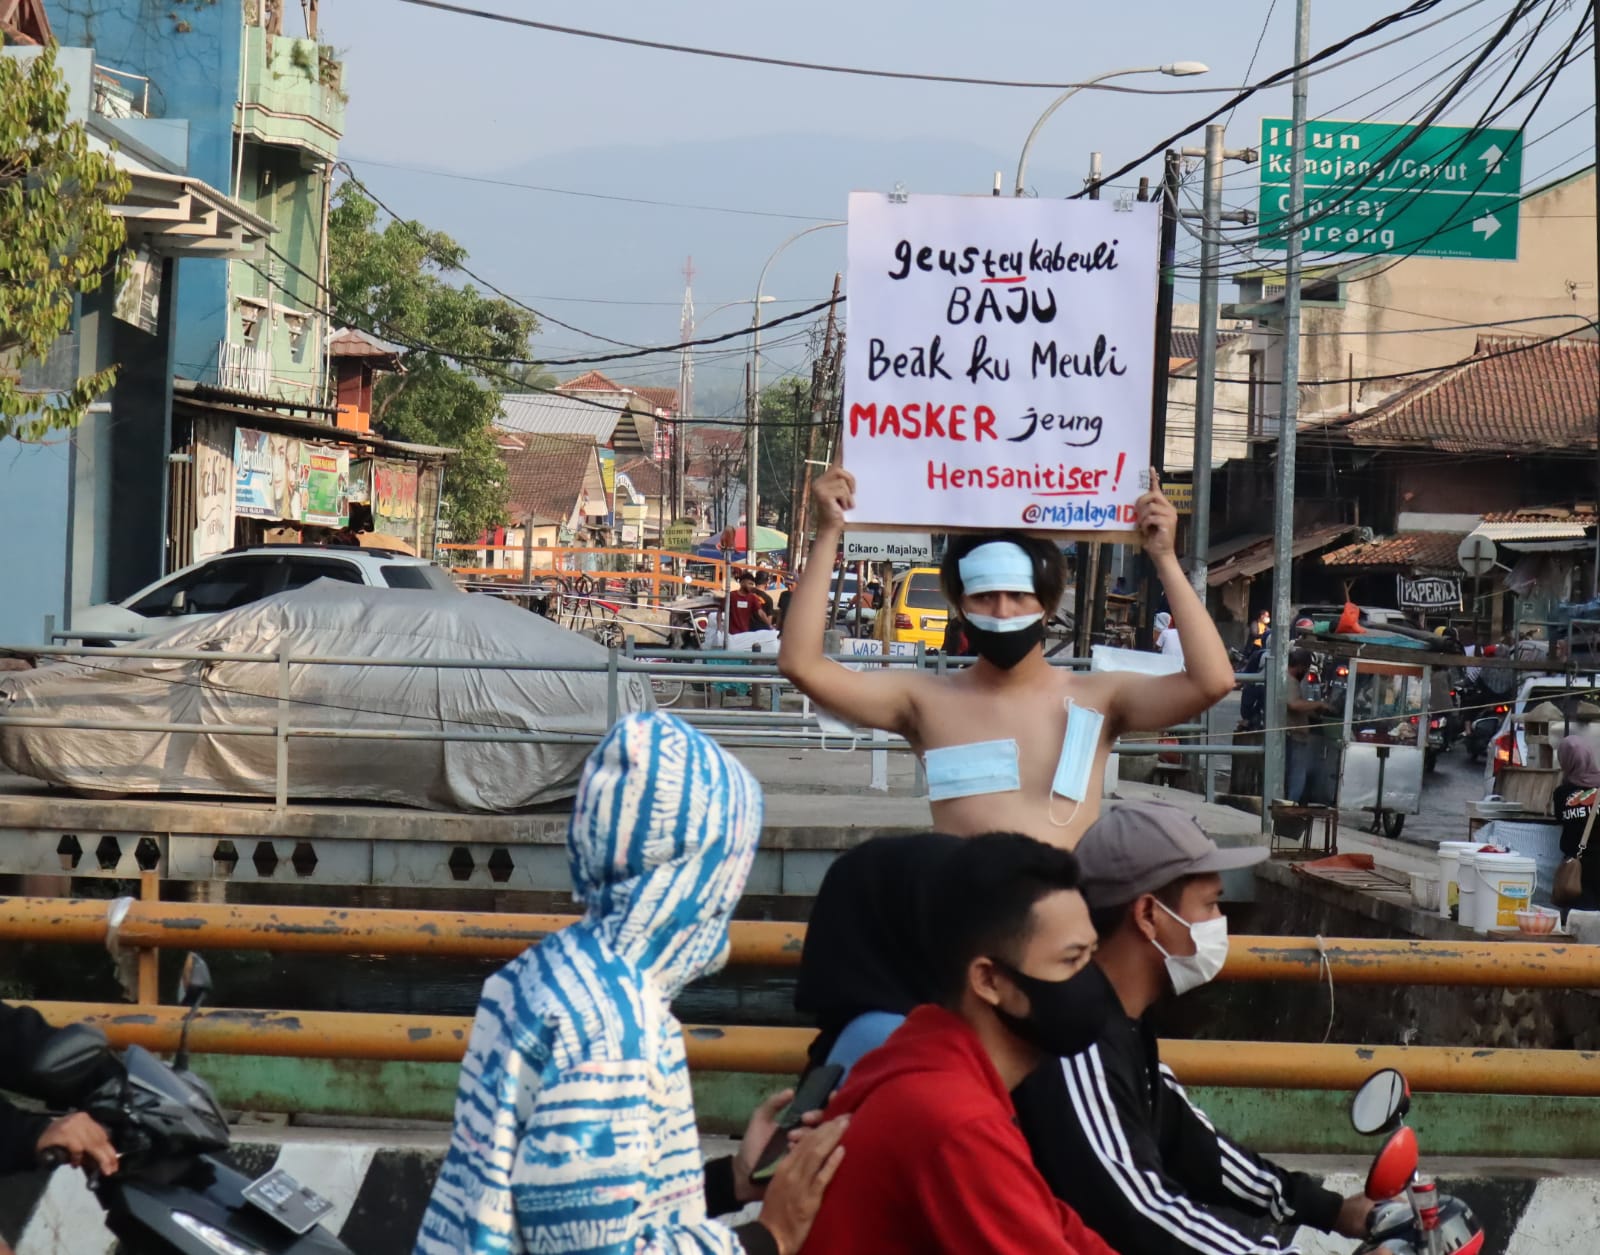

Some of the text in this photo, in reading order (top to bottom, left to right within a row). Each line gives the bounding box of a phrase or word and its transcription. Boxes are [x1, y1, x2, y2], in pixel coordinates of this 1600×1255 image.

[1278, 194, 1387, 222] Cparay
[1279, 221, 1395, 249] oreang
[887, 239, 980, 281] geus
[1029, 238, 1119, 274] kabeuli
[946, 286, 1058, 326] BAJU
[867, 333, 1128, 385] Beak ku Meuli
[849, 401, 1104, 448] MASKER jeung
[848, 543, 879, 554] Cikaro
[886, 544, 928, 557] Majalaya
